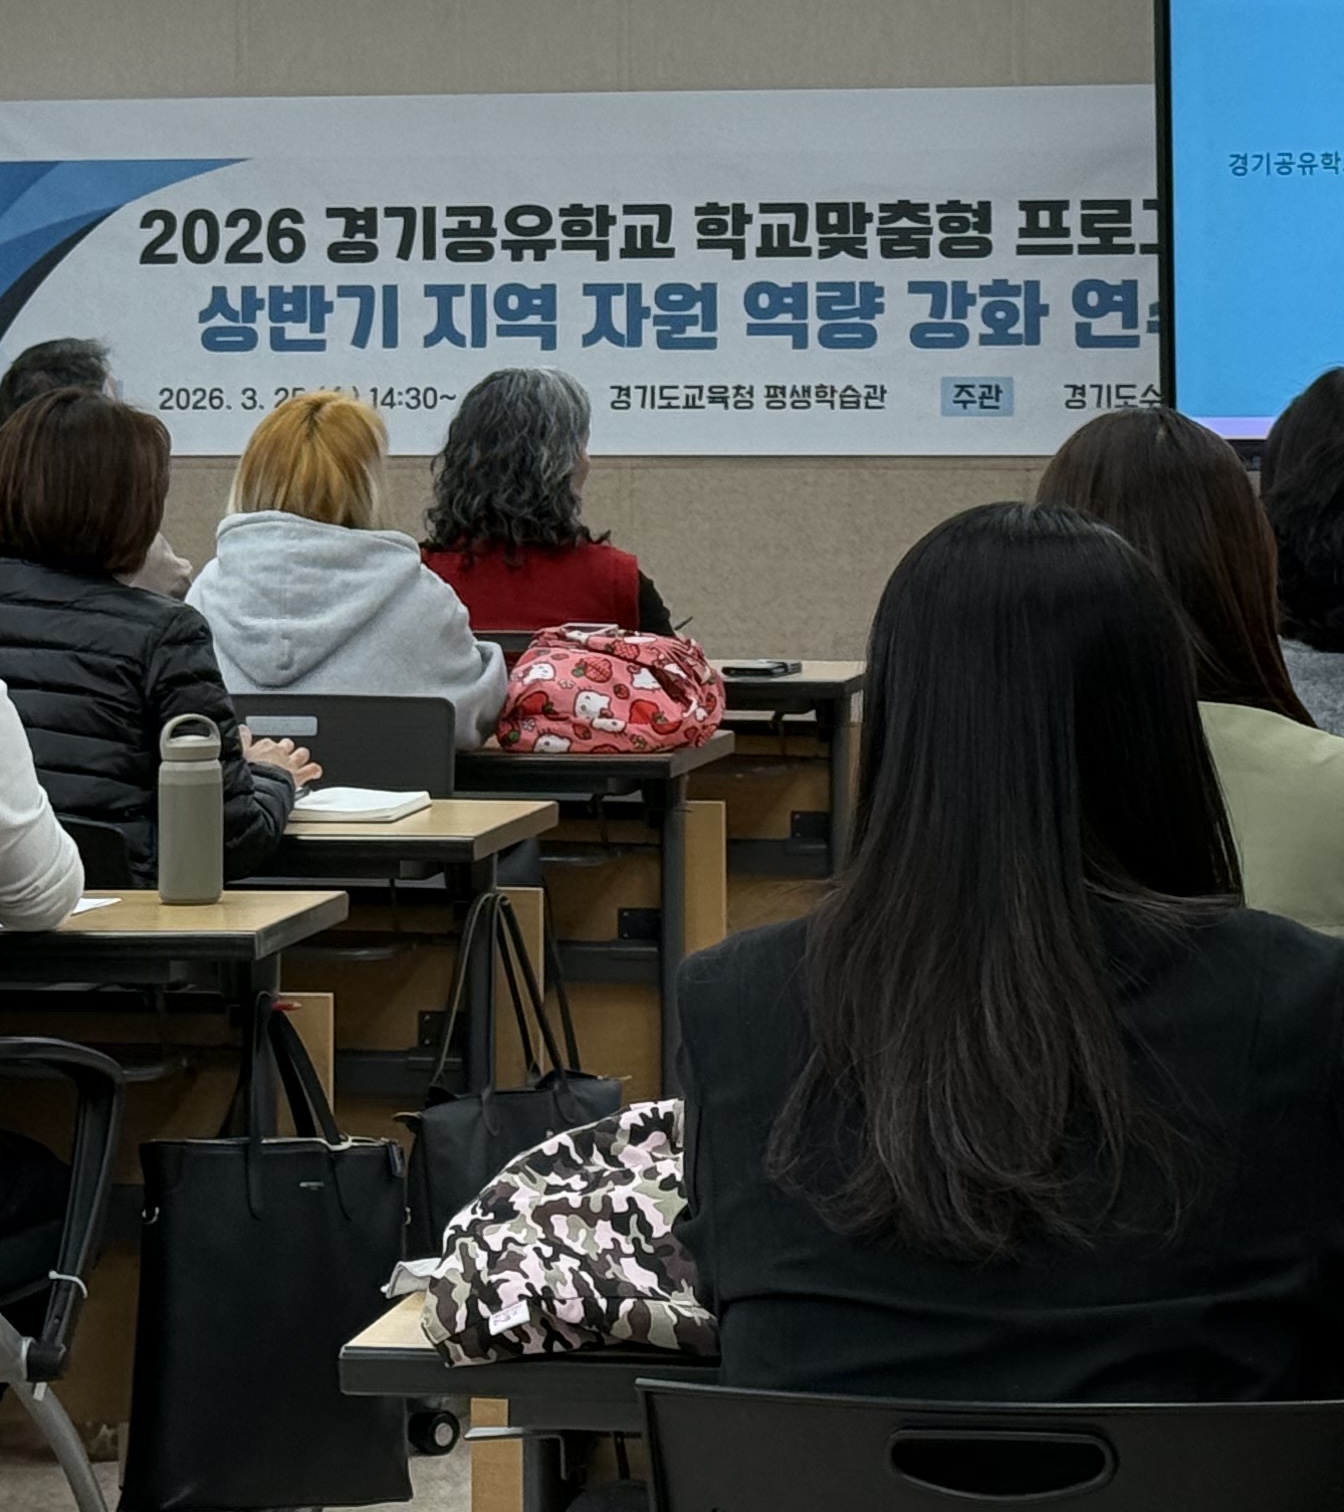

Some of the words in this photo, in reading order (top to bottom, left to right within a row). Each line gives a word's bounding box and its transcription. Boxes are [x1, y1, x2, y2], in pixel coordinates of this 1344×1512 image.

[139, 207, 306, 265] 2026
[325, 203, 676, 264] 경기공유학교
[694, 199, 994, 261] 학교맞춤형
[198, 284, 399, 353] 상반기
[423, 282, 558, 352] 지역
[581, 282, 718, 350] 자원
[744, 281, 885, 350] 역량
[907, 279, 1050, 349] 강화
[1072, 278, 1160, 349] 연
[159, 387, 233, 410] 2026.
[241, 387, 265, 410] 3.
[609, 384, 755, 411] 경기도교육청
[763, 383, 888, 411] 평생학습관
[952, 383, 1004, 410] 주관
